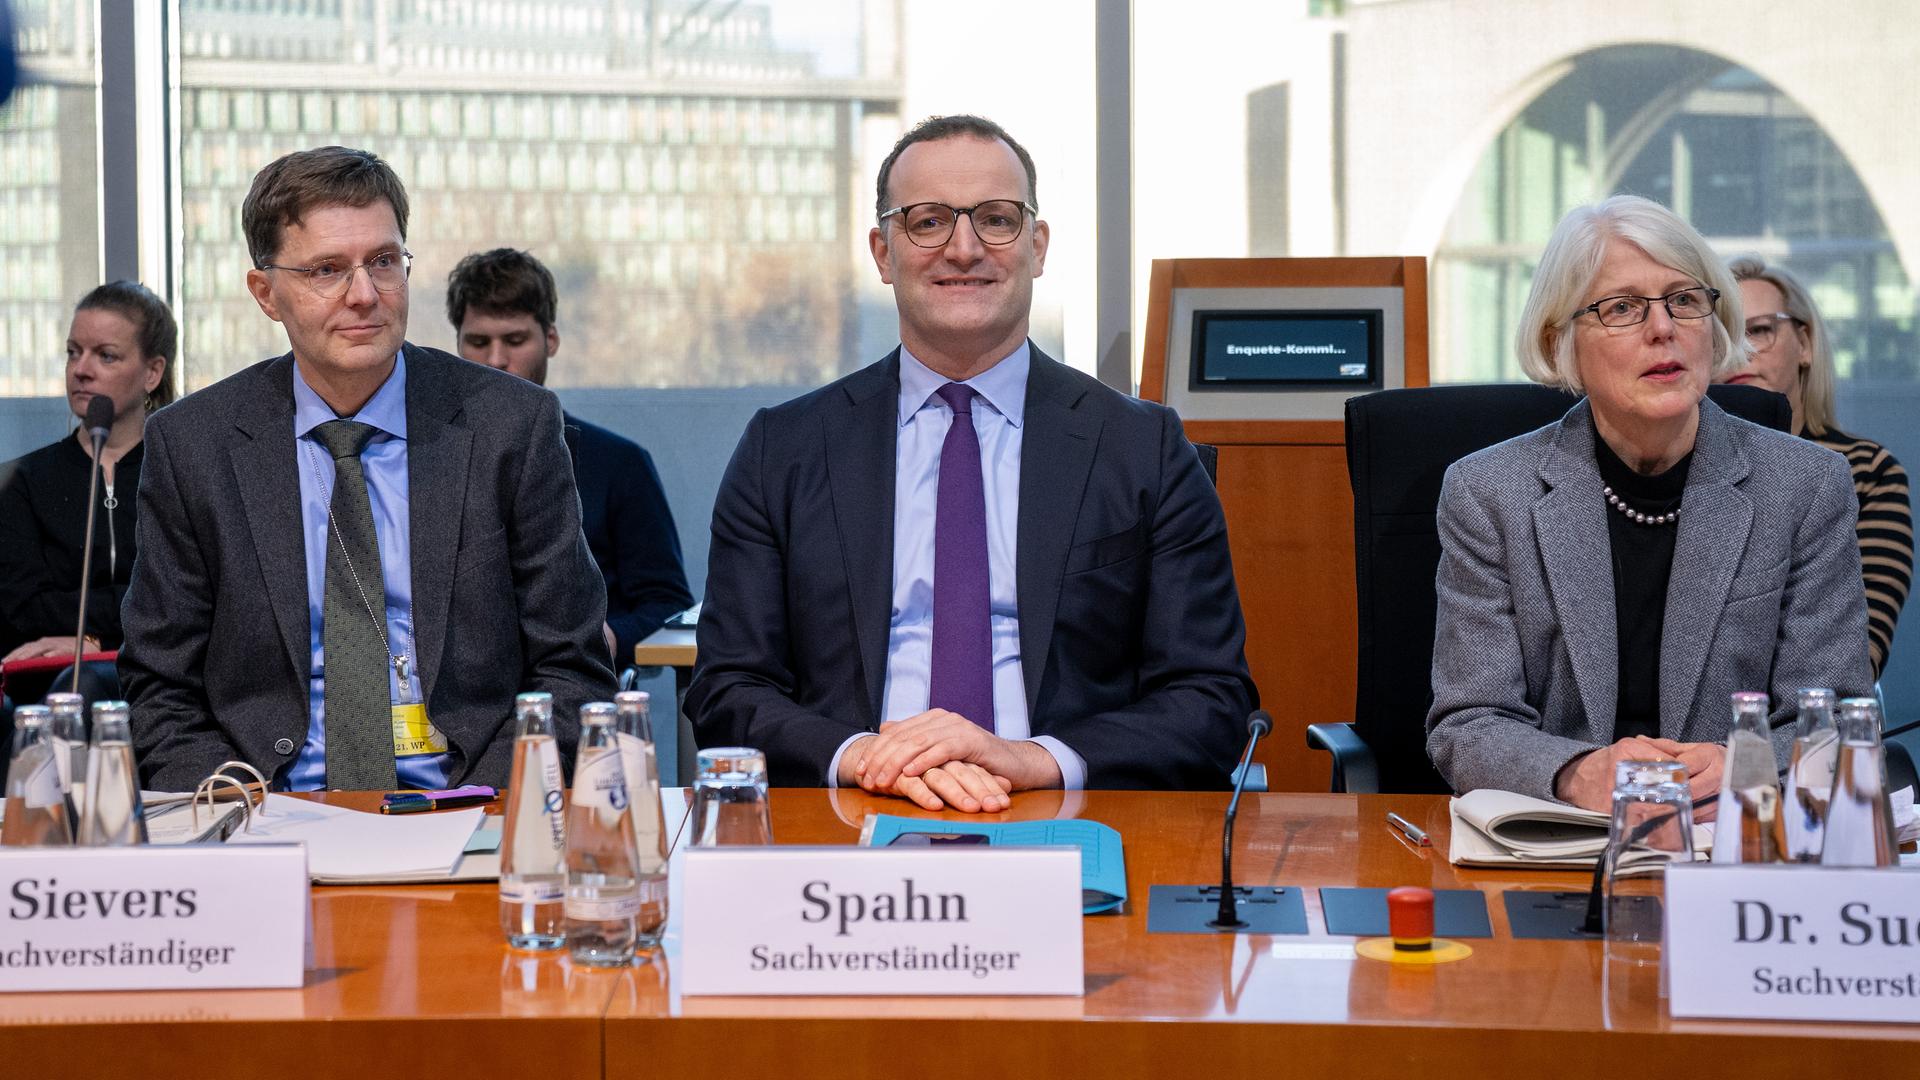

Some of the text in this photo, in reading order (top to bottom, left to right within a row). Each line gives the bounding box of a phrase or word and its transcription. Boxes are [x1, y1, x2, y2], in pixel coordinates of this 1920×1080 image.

[1226, 344, 1346, 356] Enquete-Kommi...
[411, 741, 425, 750] WP
[9, 878, 198, 920] Sievers
[801, 878, 969, 937] Spahn
[1733, 900, 1920, 946] Dr. Su
[750, 943, 1021, 979] Sachverständiger
[1753, 965, 1920, 997] Sachverst
